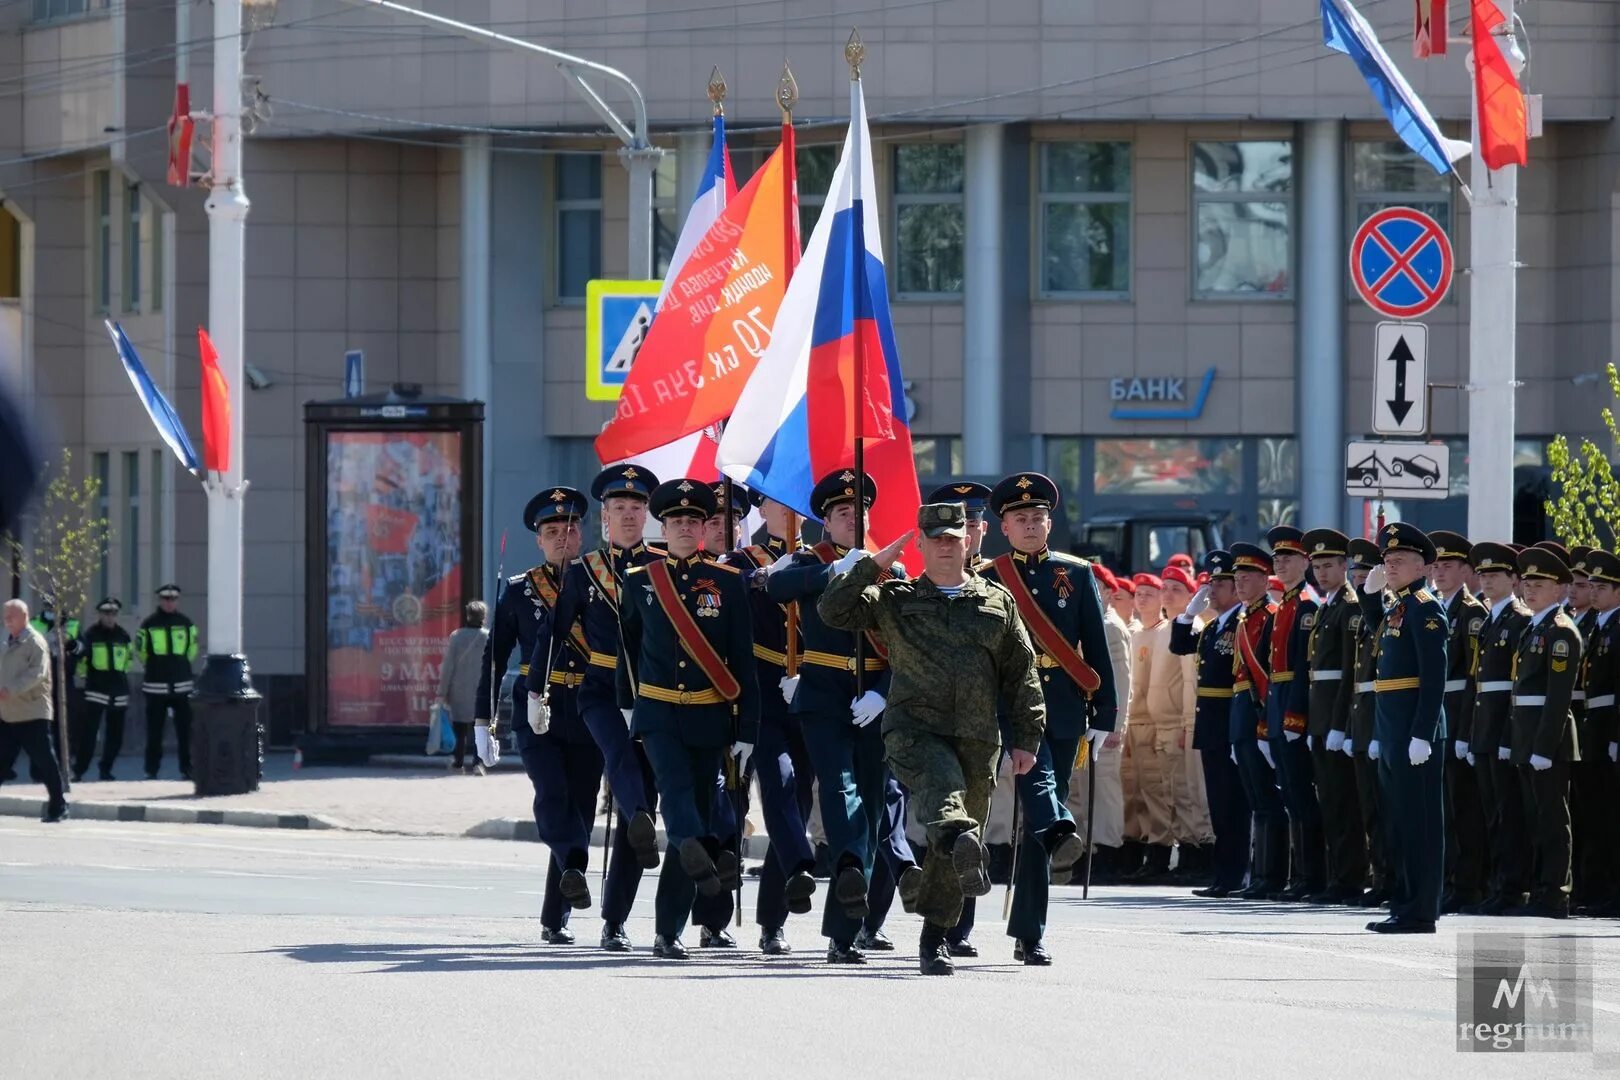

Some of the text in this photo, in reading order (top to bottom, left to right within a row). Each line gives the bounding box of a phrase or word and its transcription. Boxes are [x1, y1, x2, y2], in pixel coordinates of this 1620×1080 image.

[1110, 377, 1185, 401] БАНК
[381, 662, 441, 681] 9 МА
